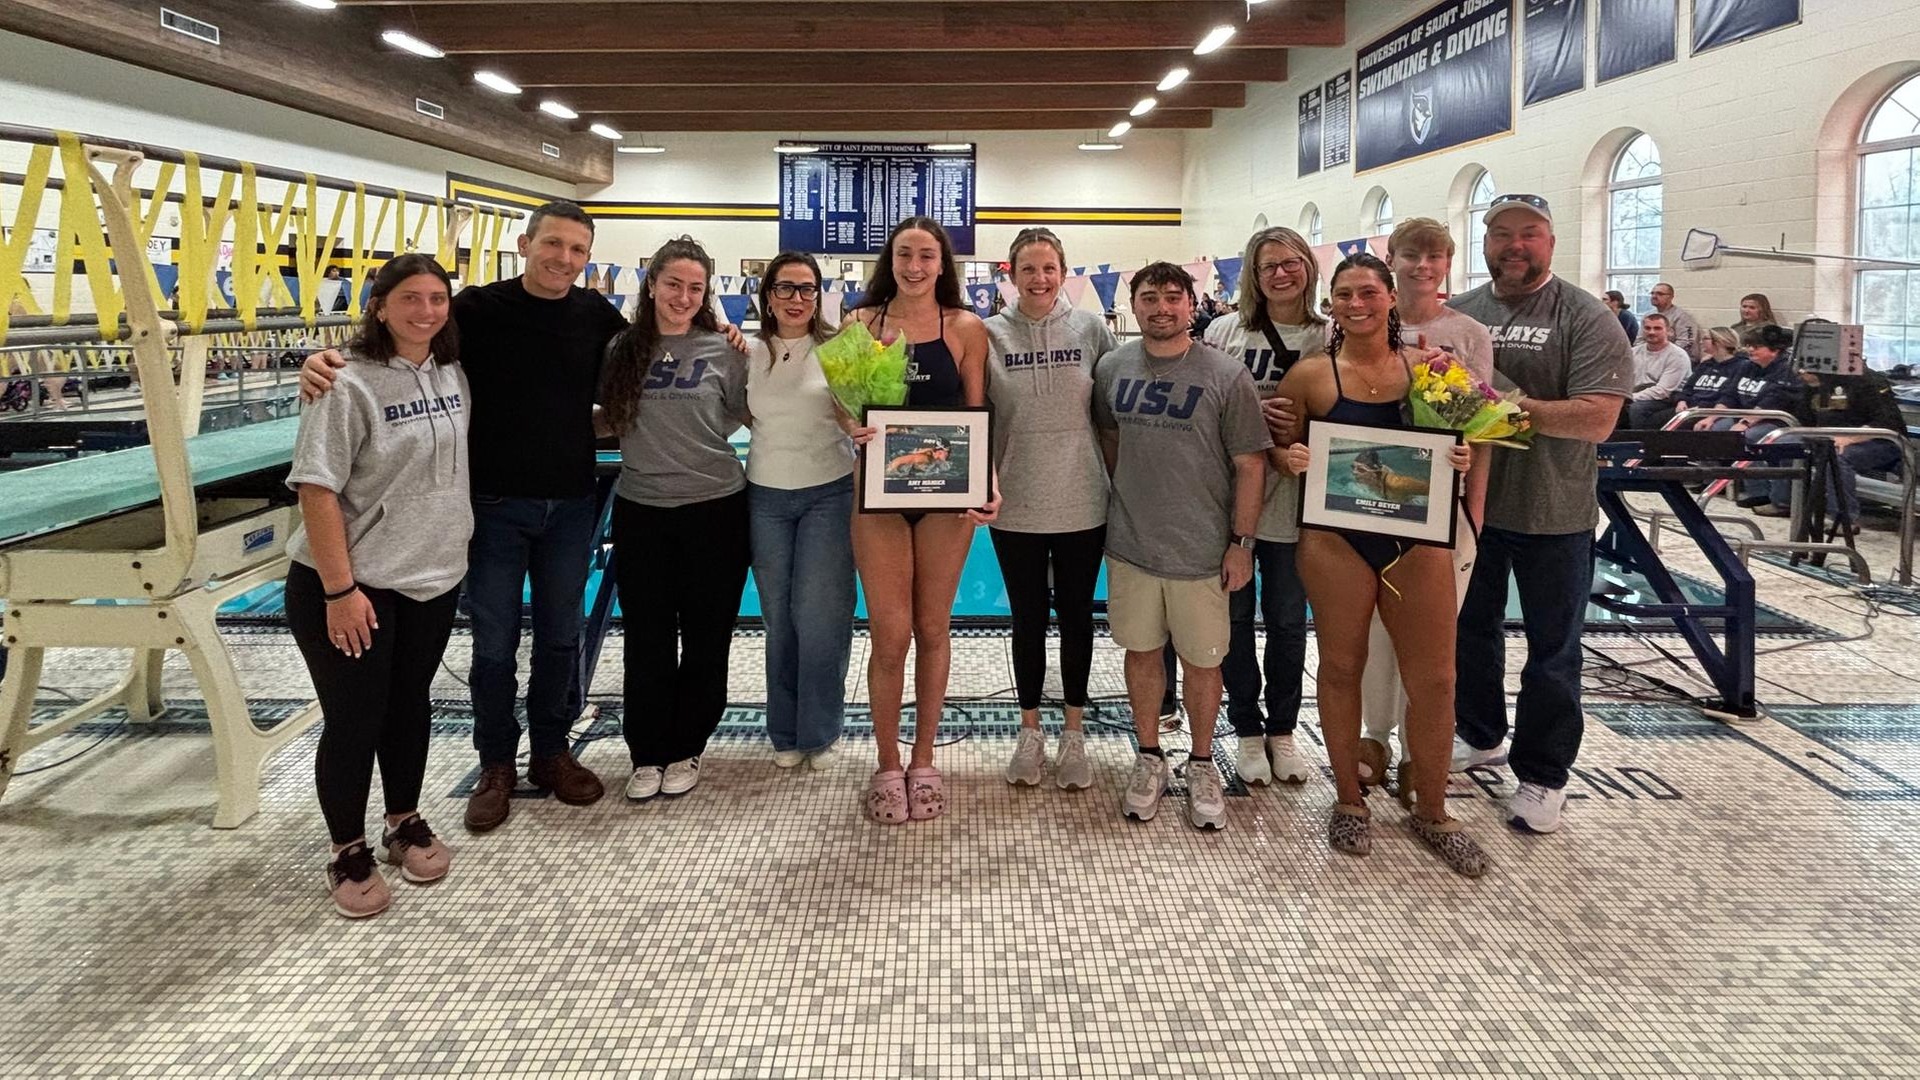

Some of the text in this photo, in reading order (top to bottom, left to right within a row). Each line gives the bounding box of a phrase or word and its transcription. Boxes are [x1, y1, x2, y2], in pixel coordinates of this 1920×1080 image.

[1360, 0, 1495, 72] UNIVERSITY OF SAINT JOS
[1359, 48, 1428, 99] SWIMMING
[1431, 40, 1442, 66] &
[1445, 8, 1508, 60] DIVING
[862, 145, 882, 153] JOSEPH
[147, 240, 167, 251] OEY
[975, 288, 990, 309] 3
[1489, 325, 1551, 344] EJAYS
[1507, 343, 1543, 351] DIVING
[643, 358, 709, 389] SJ
[1243, 349, 1301, 381] US
[384, 394, 461, 422] BLUJYS
[1115, 378, 1205, 419] USJ
[1566, 767, 1683, 800] ND
